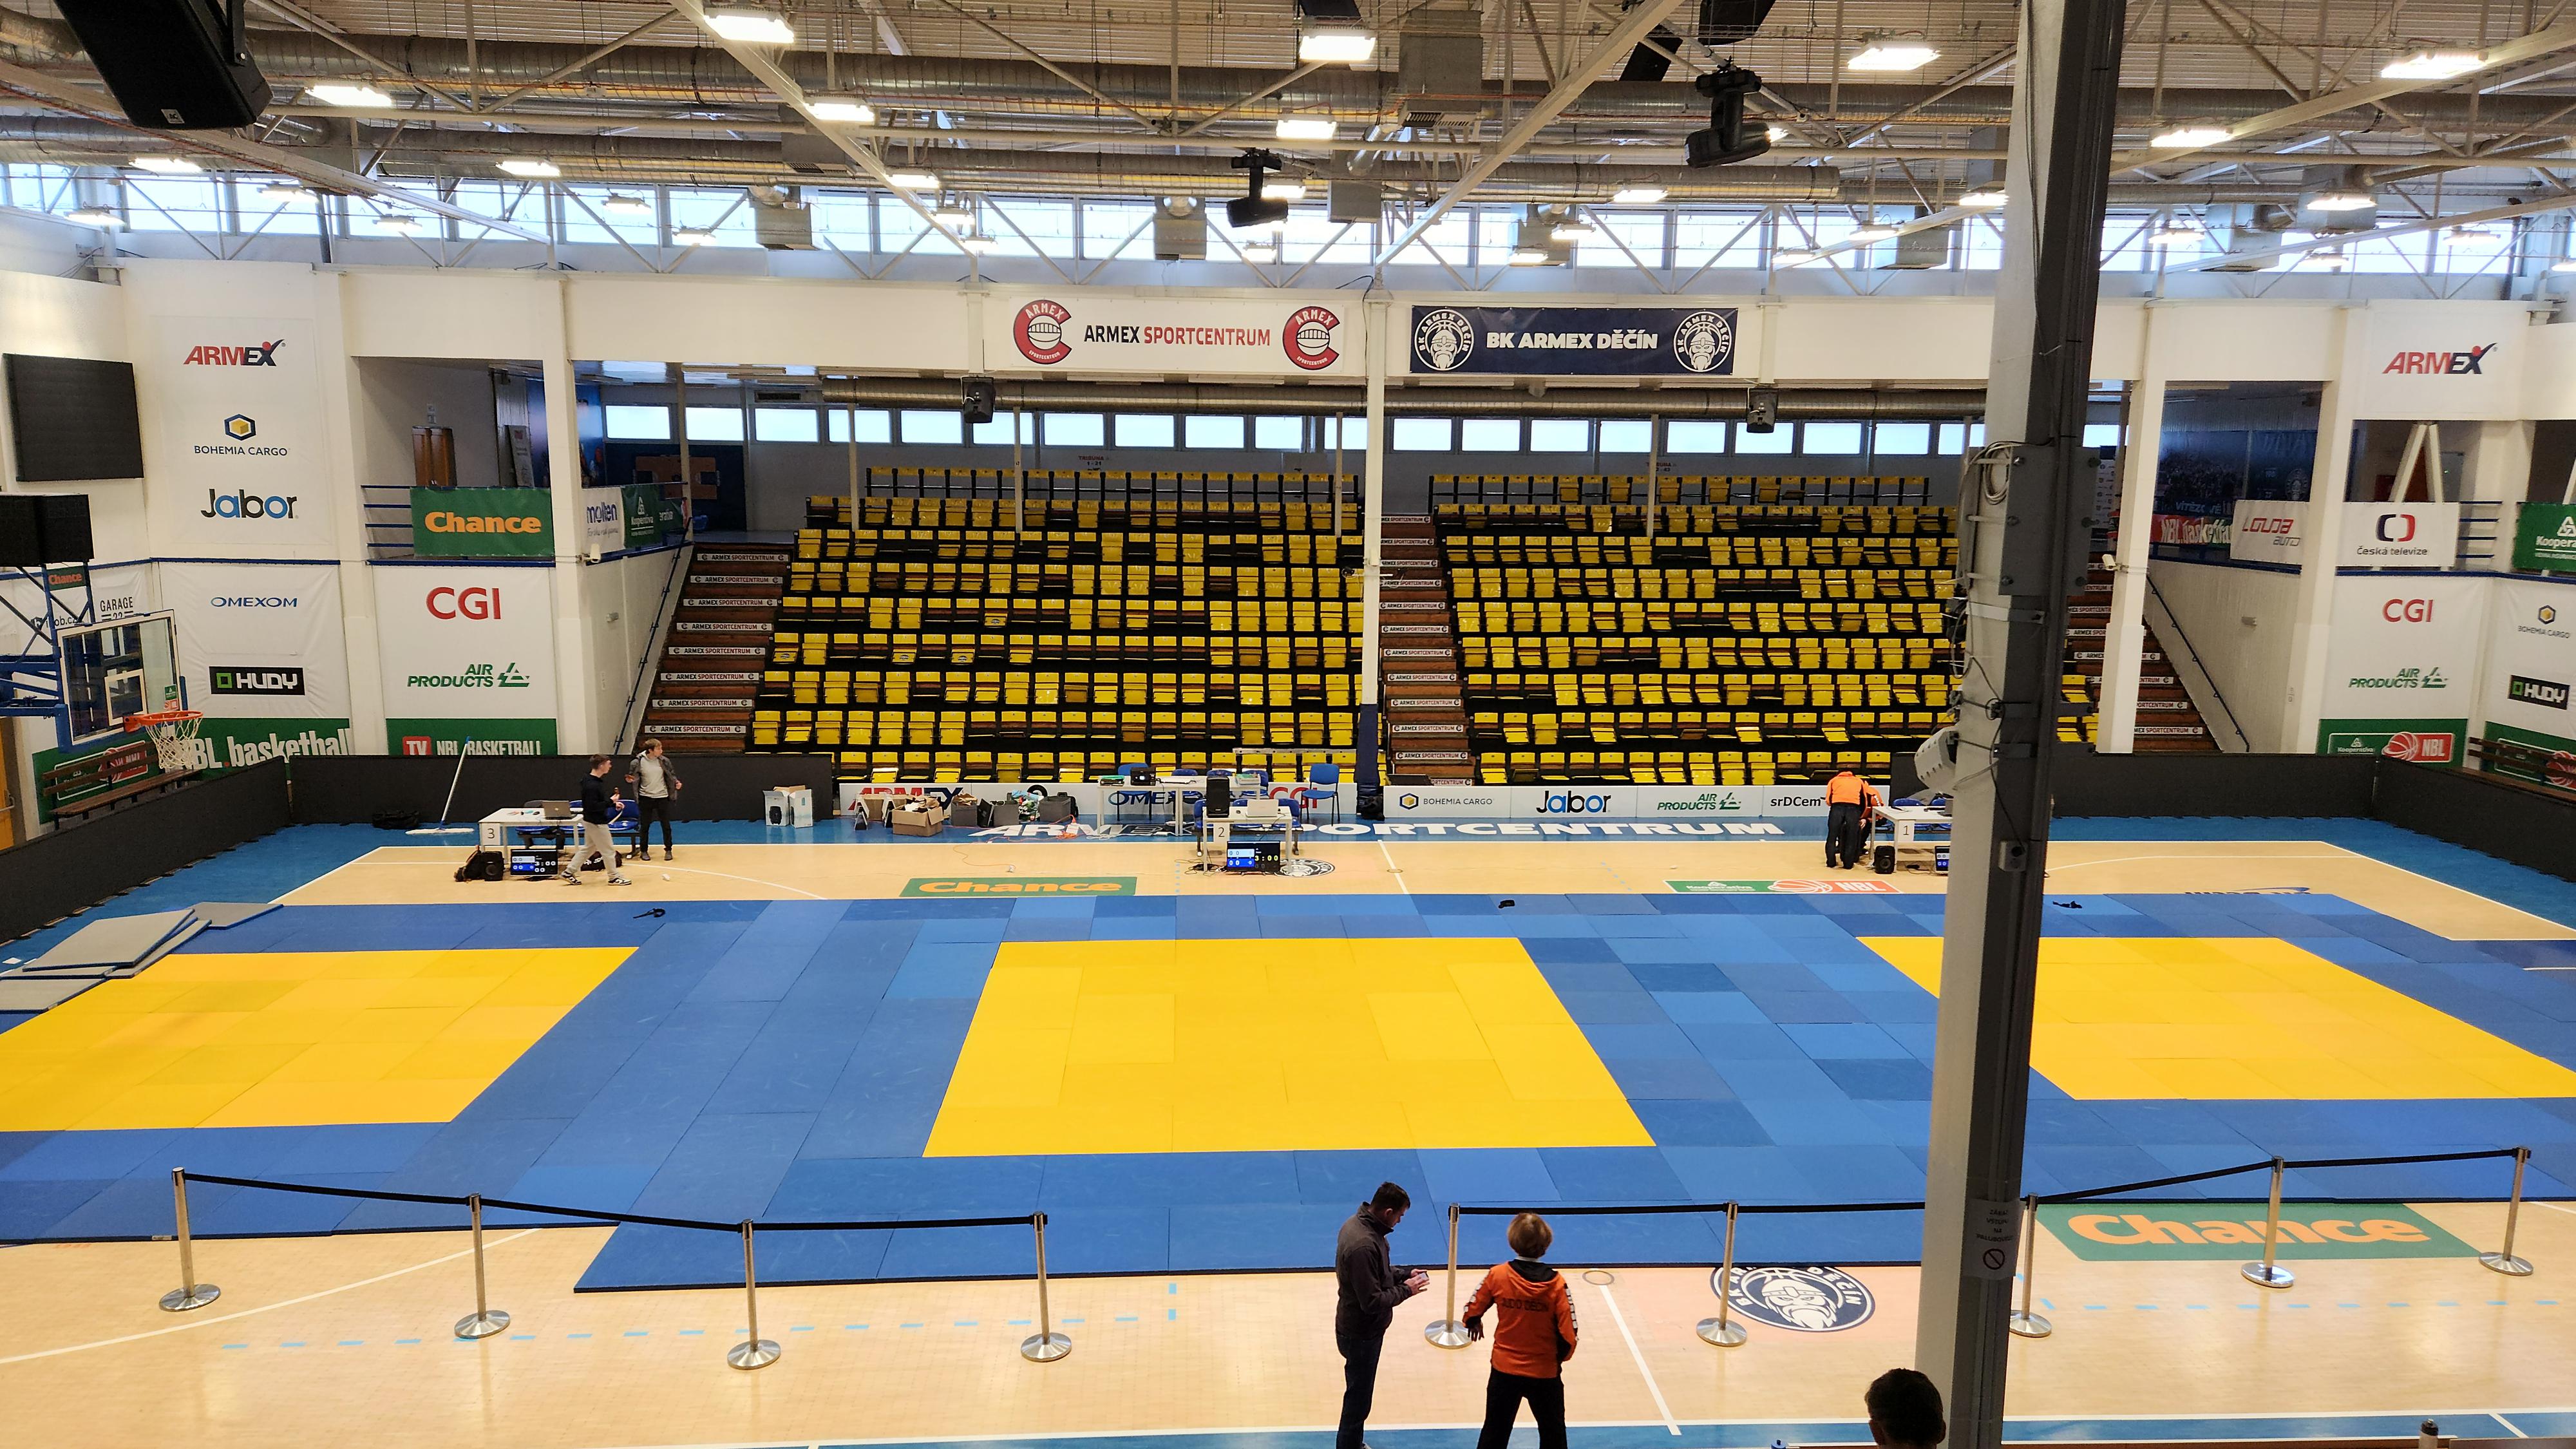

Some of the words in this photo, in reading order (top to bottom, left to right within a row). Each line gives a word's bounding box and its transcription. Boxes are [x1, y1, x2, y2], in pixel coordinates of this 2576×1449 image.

[1025, 303, 1065, 319] ARMEX
[1295, 309, 1333, 325] ARMEX
[1084, 325, 1141, 344] ARMEX
[1144, 327, 1271, 346] SPORTCENTRUM
[1486, 331, 1515, 348] BK
[1519, 332, 1593, 349] ARMEX
[1598, 328, 1658, 349] DĚČÍN
[183, 339, 285, 366] ARMEX
[2382, 342, 2498, 375] ARMEX
[194, 445, 245, 455] BOHEMIA
[247, 446, 287, 456] CARGO
[200, 488, 297, 519] Jabor
[586, 502, 618, 524] molten
[425, 511, 542, 533] Chance
[2536, 536, 2576, 549] Koopera
[2356, 545, 2387, 555] Česká
[2390, 546, 2427, 555] televize
[48, 573, 82, 585] Chance
[100, 596, 134, 612] GARAGE
[211, 597, 298, 607] OMEXOM
[426, 587, 501, 620] CGI
[2382, 599, 2434, 623] CGI
[2517, 625, 2546, 636] BOHEMIA
[2546, 628, 2571, 639] CARGO
[464, 664, 493, 676] AIR
[2396, 668, 2420, 678] AIR
[236, 673, 298, 689] HUDY
[407, 676, 494, 688] PRODUCTS
[2348, 678, 2418, 688] PRODUCTS
[2523, 684, 2566, 703] HUDY
[406, 741, 428, 755] TV
[2421, 739, 2445, 757] NBL
[1536, 790, 1611, 813] Jabor
[1697, 793, 1717, 802] AIR
[1770, 796, 1821, 807] srDCem
[1657, 802, 1717, 810] PRODUCTS
[487, 828, 495, 839] 3
[1218, 827, 1226, 838] 2
[1902, 825, 1909, 835] 1
[919, 882, 1122, 893] Chance
[1835, 882, 1886, 891] NBL
[2067, 1214, 2431, 1244] Chance
